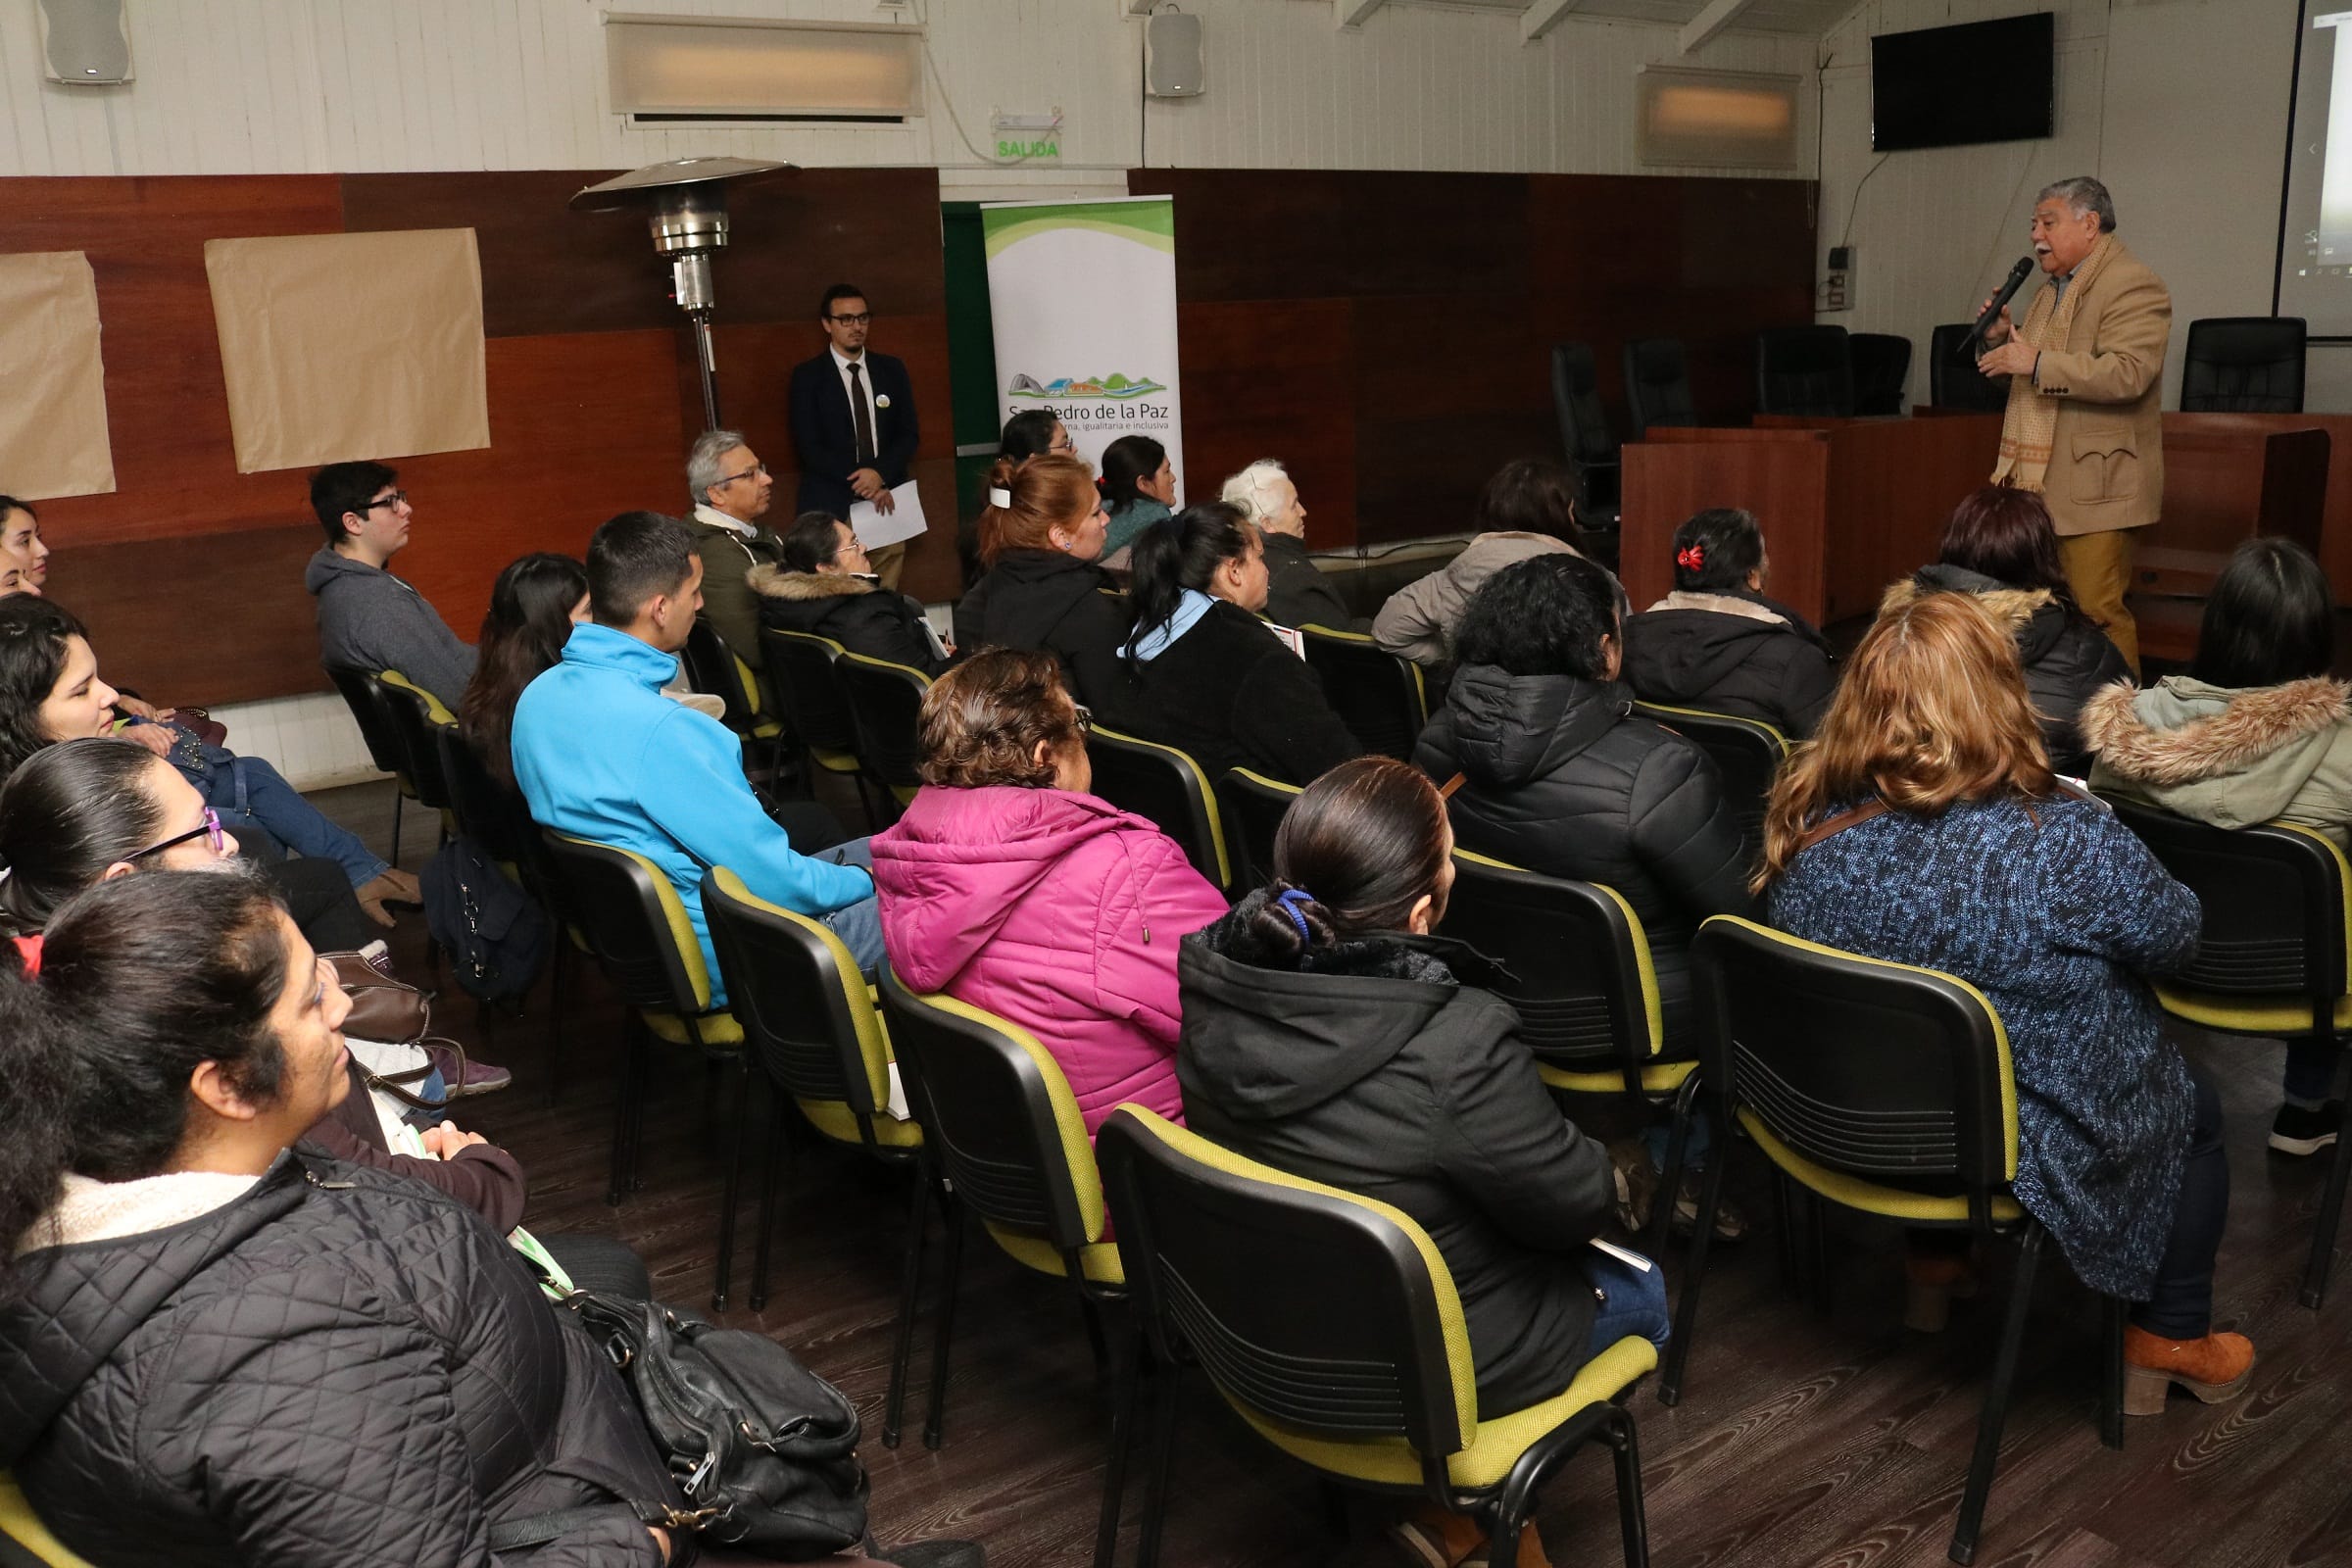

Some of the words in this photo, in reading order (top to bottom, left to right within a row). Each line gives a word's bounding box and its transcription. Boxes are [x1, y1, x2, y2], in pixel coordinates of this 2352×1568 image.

[998, 141, 1057, 158] SALIDA
[1095, 404, 1115, 419] de
[1120, 403, 1135, 419] la
[1140, 403, 1169, 419] Paz
[1082, 421, 1123, 432] igualitaria
[1133, 421, 1169, 430] inclusiva
